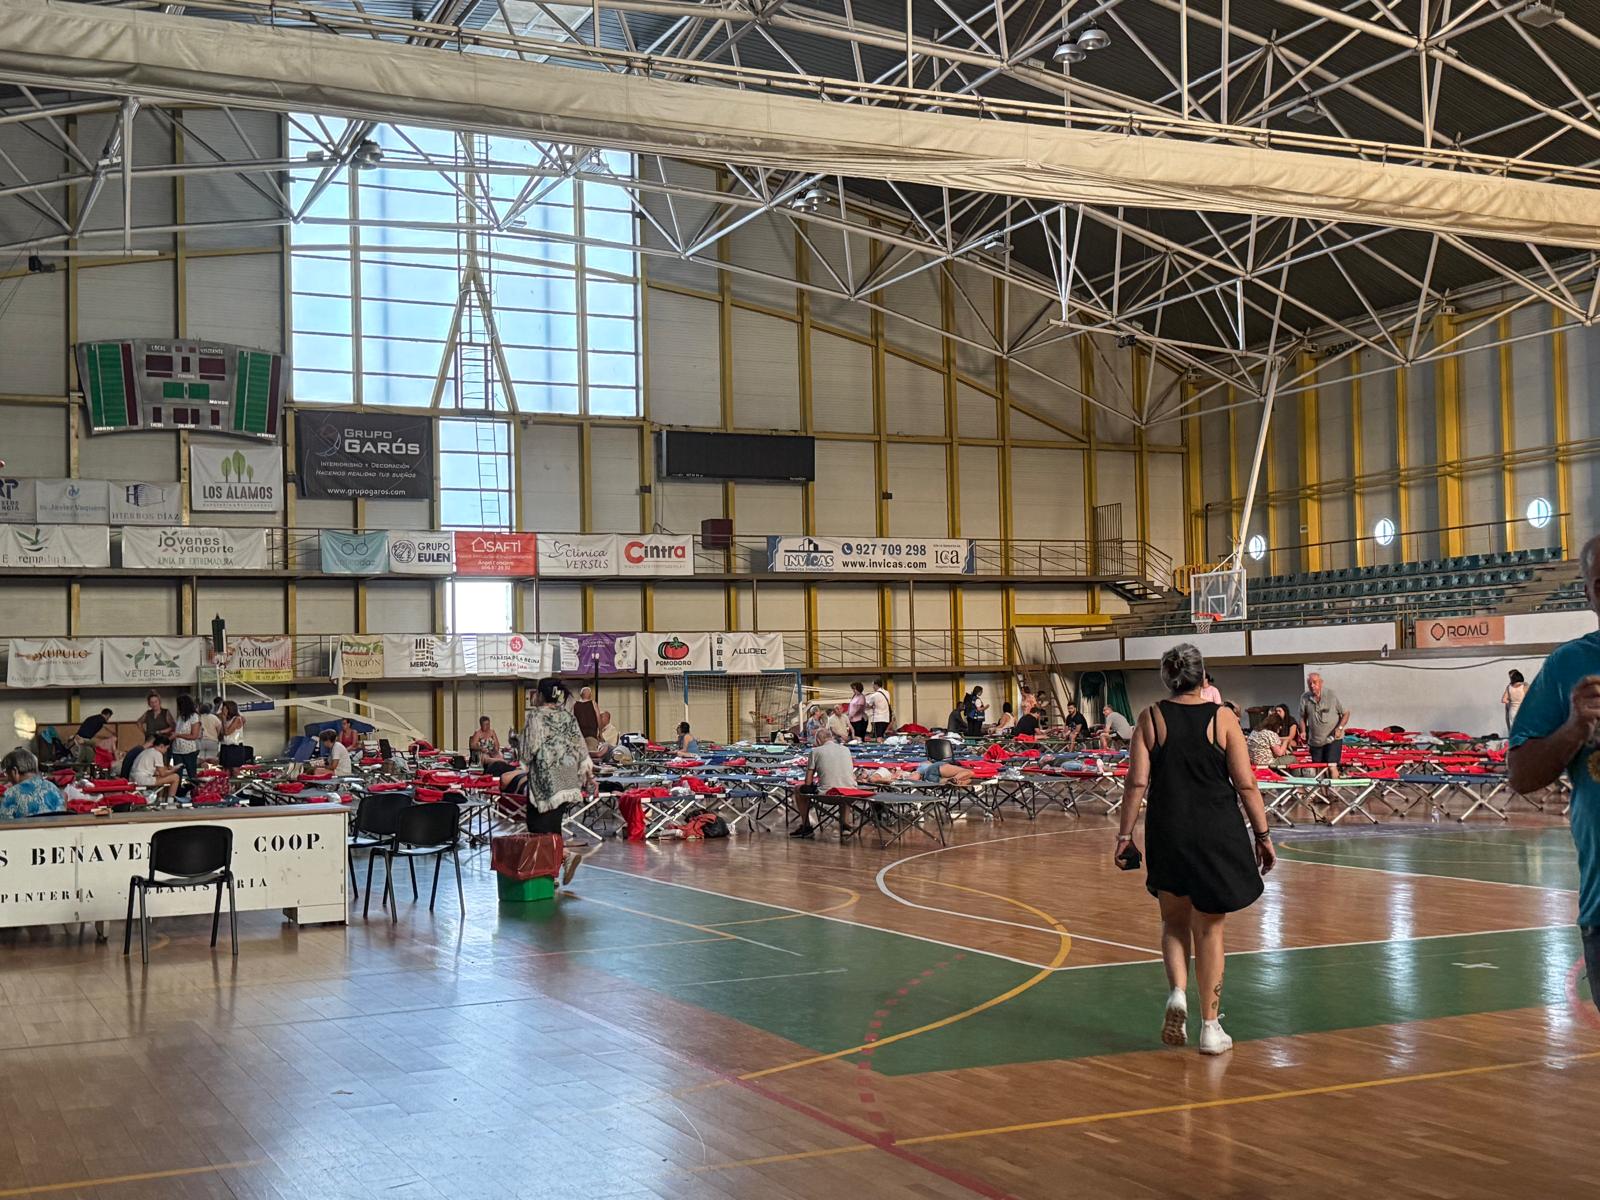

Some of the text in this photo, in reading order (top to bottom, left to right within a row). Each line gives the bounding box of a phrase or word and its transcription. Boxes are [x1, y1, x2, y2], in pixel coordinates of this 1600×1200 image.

[344, 428, 392, 439] GRUPO
[344, 437, 420, 455] GARÓS
[391, 471, 416, 479] SUEÑOS
[203, 484, 272, 500] LOS ÁLAMOS
[327, 488, 406, 497] www.grupogaros.com
[112, 512, 180, 521] HIERROS DÍAZ
[418, 543, 450, 551] GRUPO
[856, 544, 926, 556] 927 709 298
[624, 541, 686, 564] Cintra
[179, 557, 186, 565] DE
[189, 557, 234, 566] EXTREMADURA
[418, 553, 450, 563] EULEN
[565, 559, 609, 570] VERSUS
[842, 559, 927, 569] www.invicas.com
[732, 648, 767, 656] ALUDEC
[1381, 643, 1388, 656] 4
[125, 670, 181, 678] VETERPLAS
[253, 833, 325, 853] COOP.
